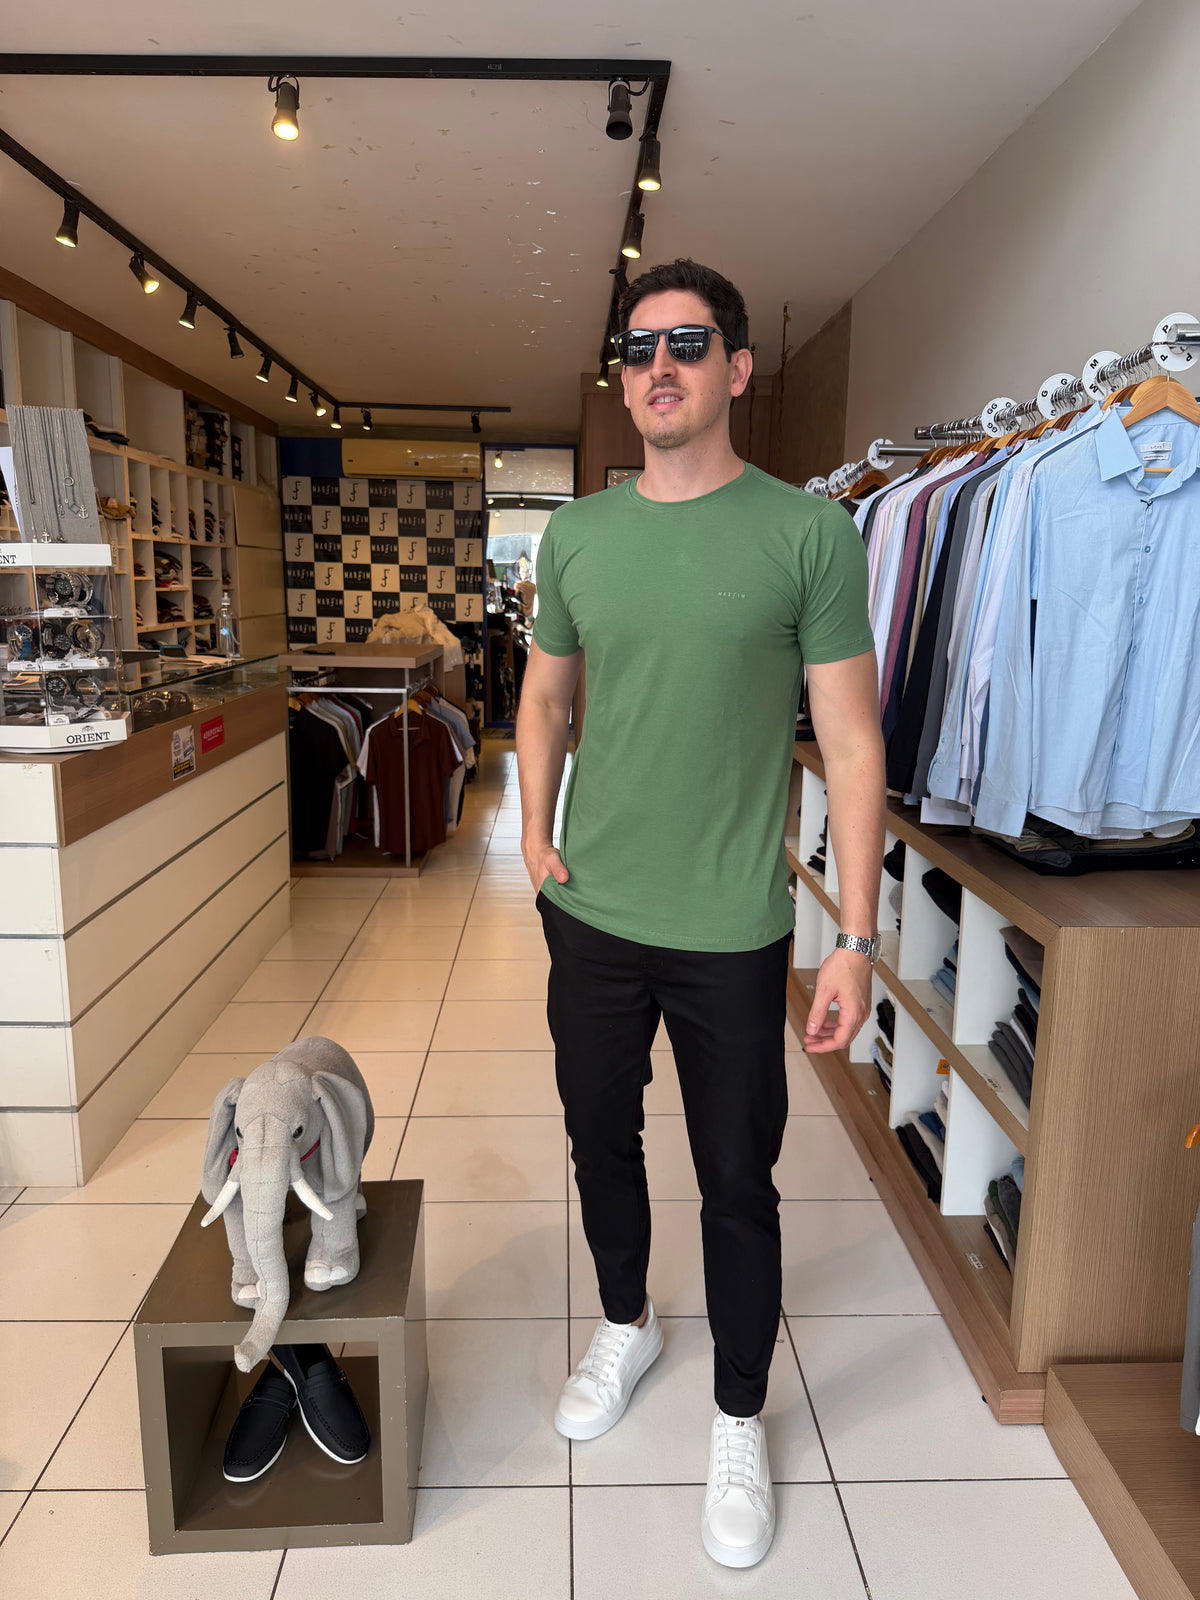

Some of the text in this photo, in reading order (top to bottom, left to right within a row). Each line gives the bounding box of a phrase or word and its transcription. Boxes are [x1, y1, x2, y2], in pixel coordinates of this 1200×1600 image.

[1090, 359, 1099, 369] M
[987, 403, 998, 415] GG
[66, 731, 111, 744] ORIENT
